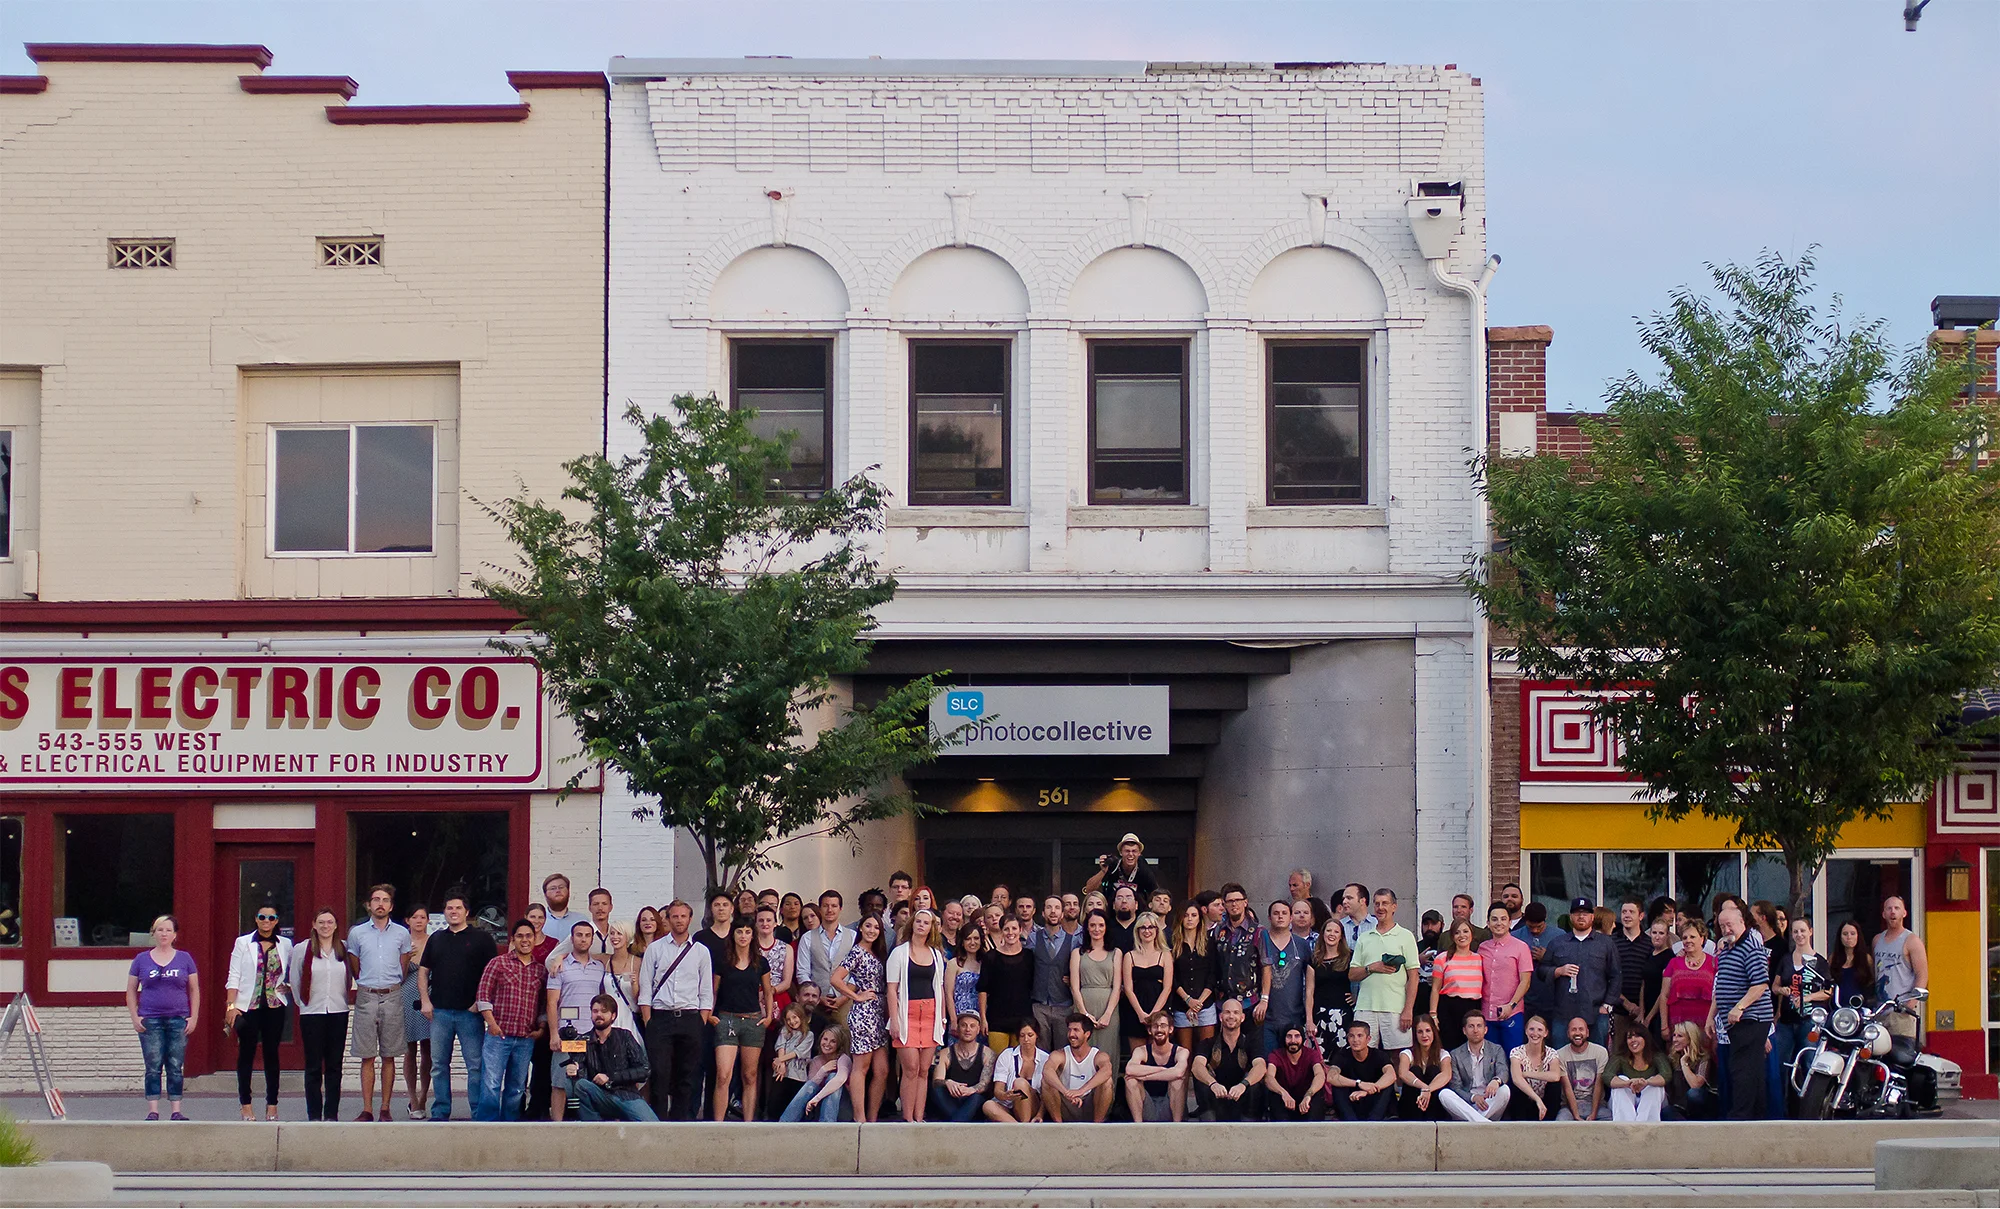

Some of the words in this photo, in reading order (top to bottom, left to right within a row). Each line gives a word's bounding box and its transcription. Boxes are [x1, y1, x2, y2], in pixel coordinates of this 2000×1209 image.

[56, 666, 381, 730] ELECTRIC
[407, 666, 520, 730] CO.
[950, 698, 978, 711] SLC
[38, 733, 143, 751] 543-555
[155, 733, 222, 751] WEST
[965, 720, 1152, 746] photocollective
[21, 754, 165, 773] ELECTRICAL
[178, 754, 319, 774] EQUIPMENT
[329, 754, 376, 773] FOR
[386, 754, 509, 773] INDUSTRY
[1037, 786, 1069, 807] 561
